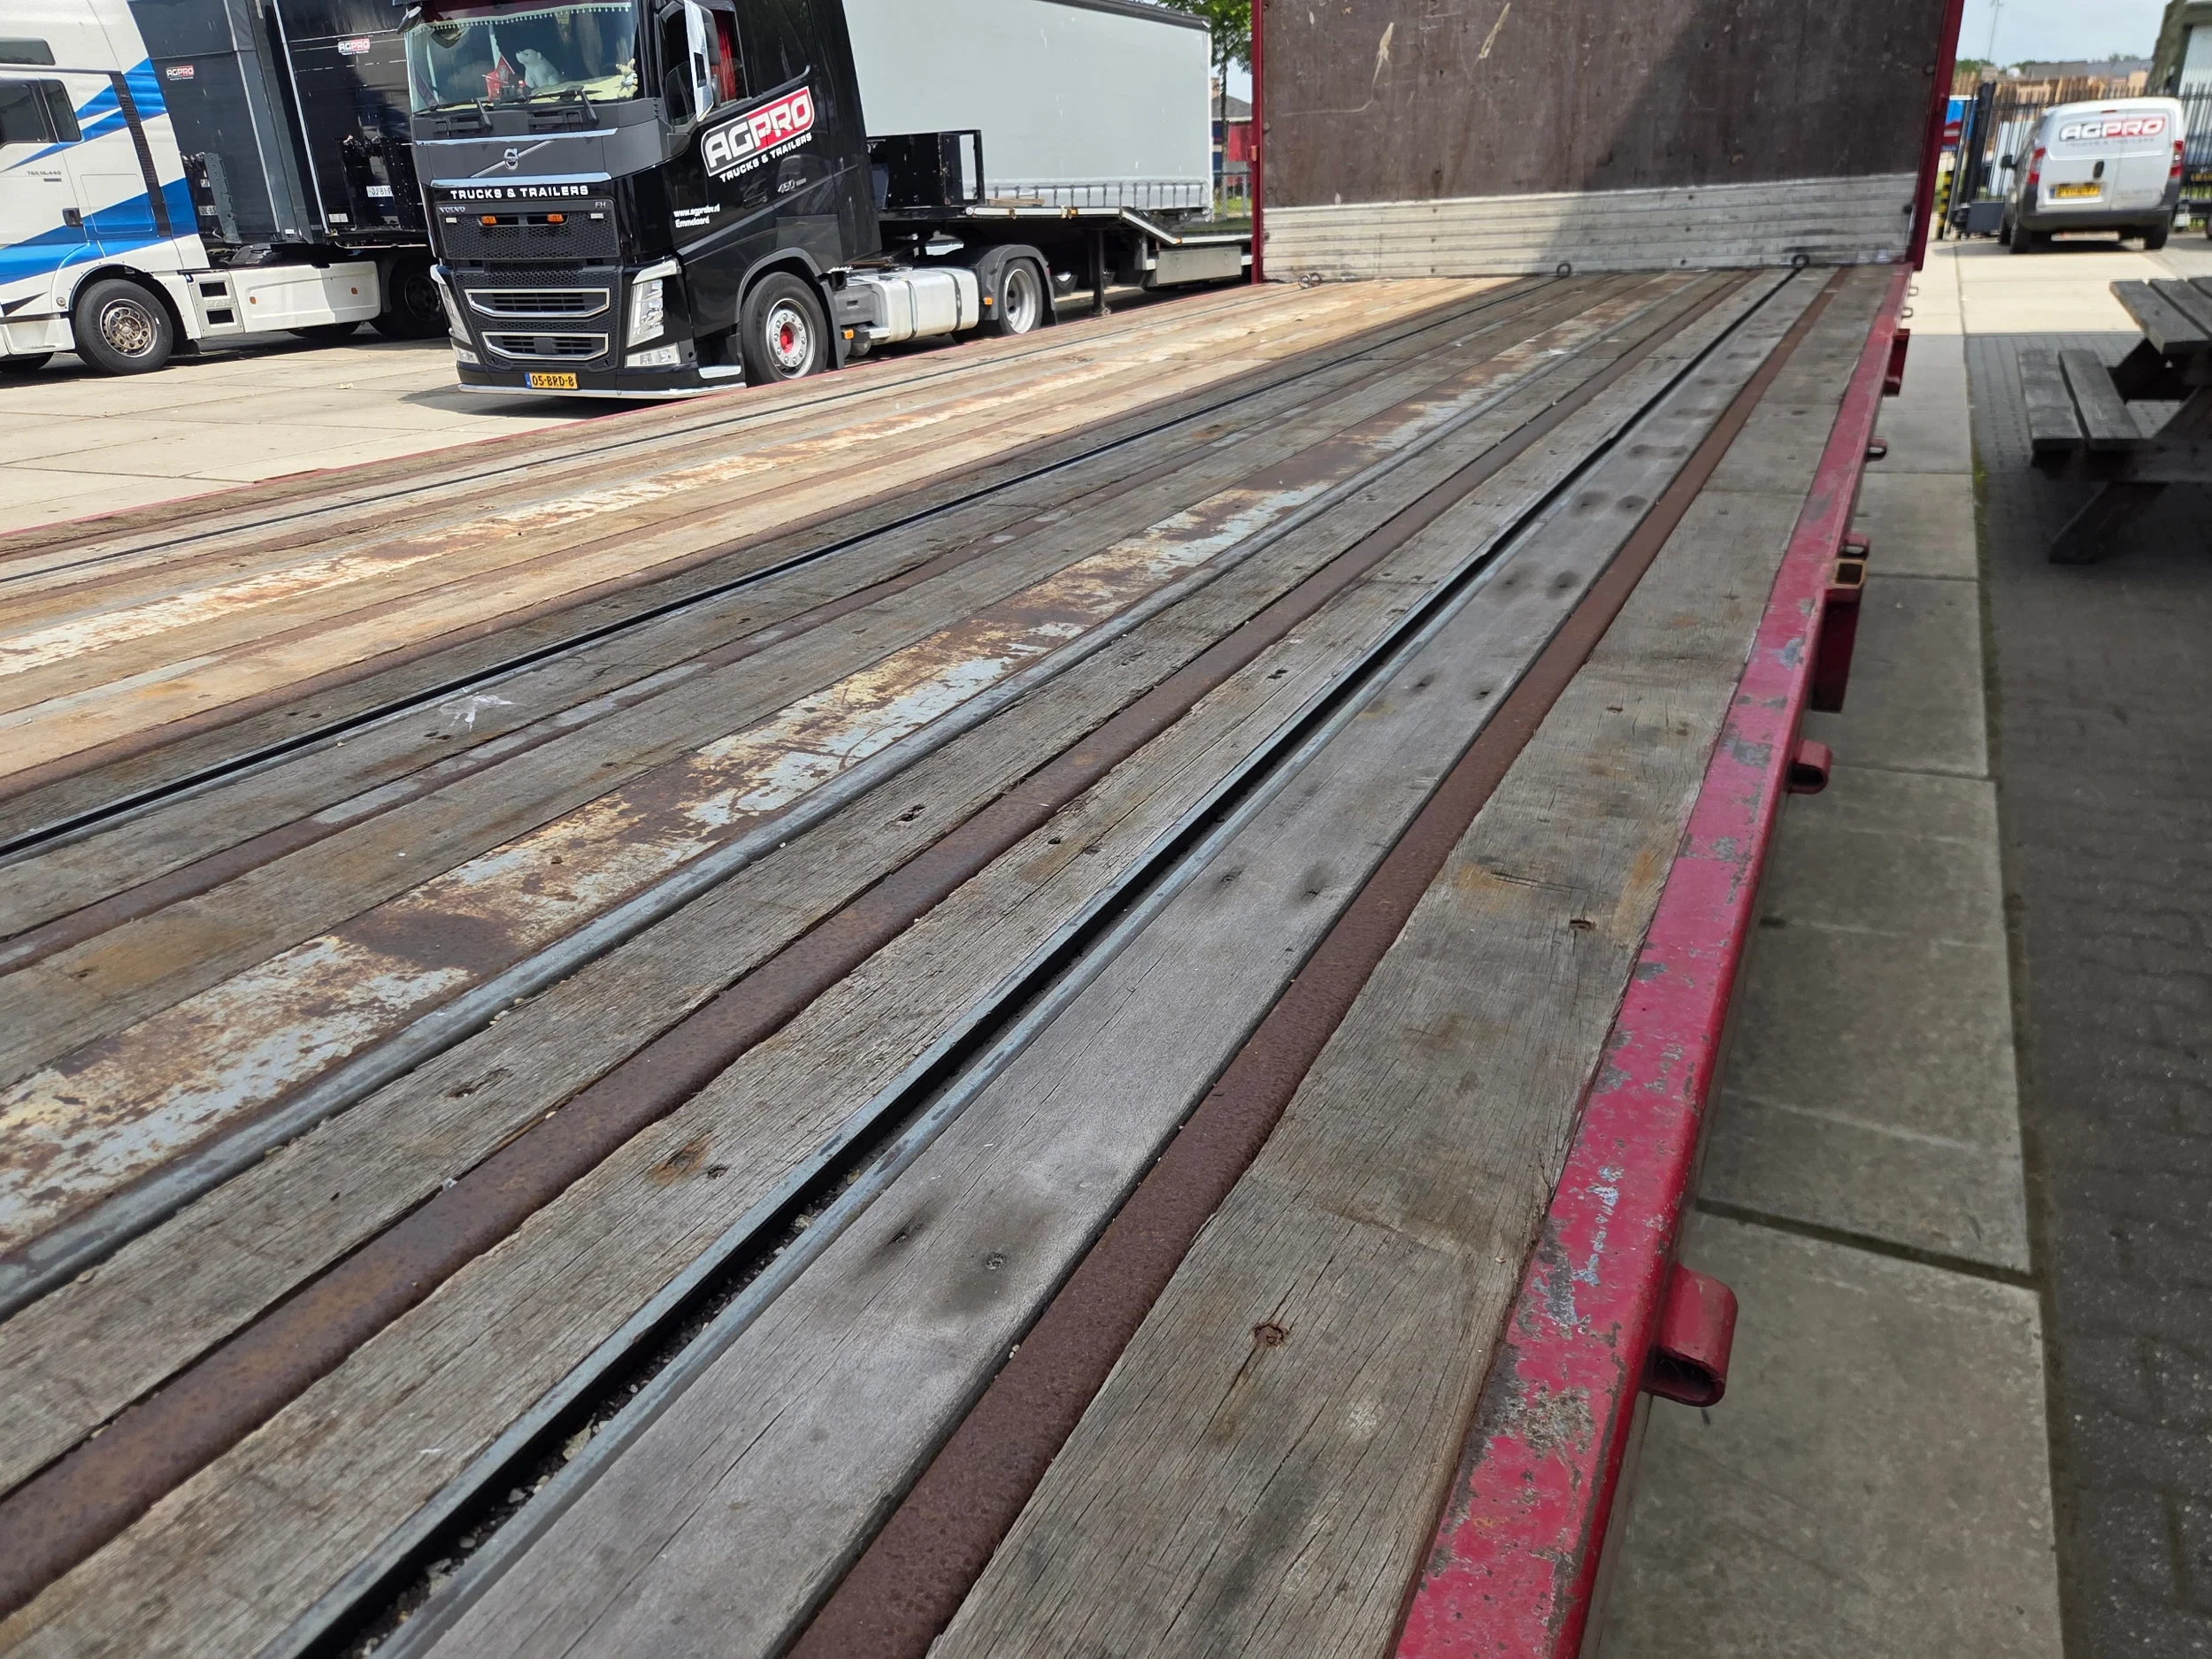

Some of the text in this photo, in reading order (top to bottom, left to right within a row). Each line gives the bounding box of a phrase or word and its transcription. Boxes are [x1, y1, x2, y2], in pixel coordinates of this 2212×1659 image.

[339, 41, 369, 51] AGPRO
[166, 67, 194, 76] AGPRO
[704, 93, 811, 168] AGPRO
[2061, 119, 2164, 140] AGPRO
[719, 132, 812, 182] TRUCKS & TRAILERS
[450, 185, 588, 199] TRUCKS & TRAILERS
[673, 203, 721, 218] www.agprobv.nl
[675, 215, 710, 228] Emmeloord
[532, 375, 574, 387] 05-BRD-8
